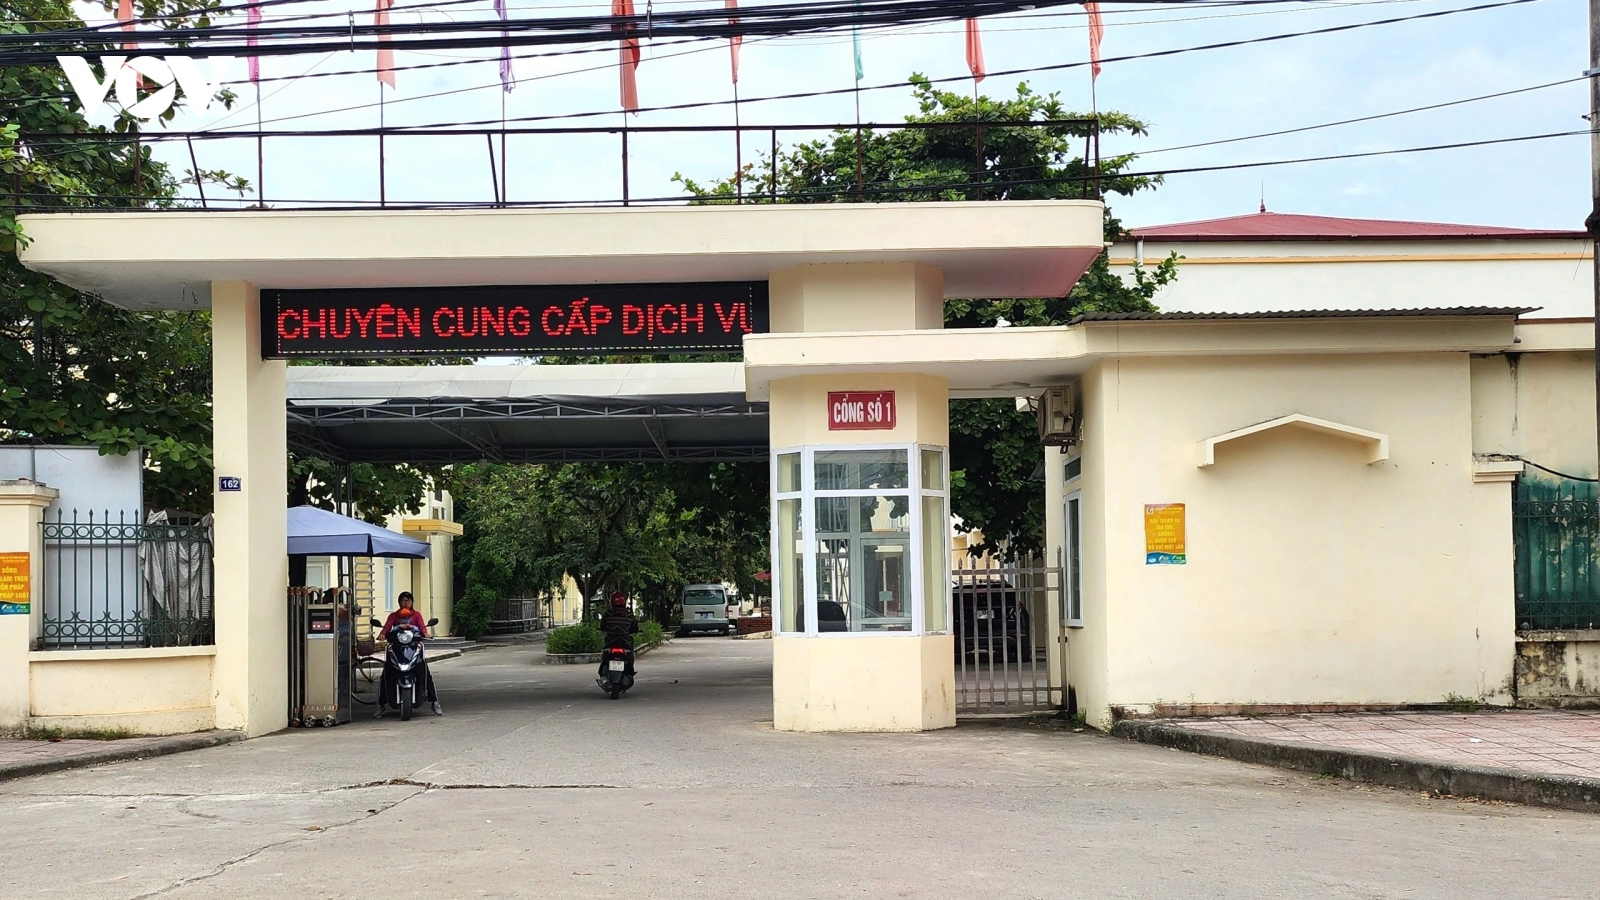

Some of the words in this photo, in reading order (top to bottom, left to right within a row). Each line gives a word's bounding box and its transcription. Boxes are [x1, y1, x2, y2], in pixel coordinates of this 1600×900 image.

[278, 303, 421, 339] CHUYÊN
[432, 306, 531, 337] CUNG
[541, 297, 613, 336] CẤP
[622, 302, 704, 341] DỊCH
[833, 393, 865, 424] CỔNG
[867, 393, 883, 423] SỐ
[885, 401, 891, 422] 1
[222, 479, 239, 489] 162
[1, 566, 18, 574] SỐNG
[15, 591, 29, 599] LUẬT
